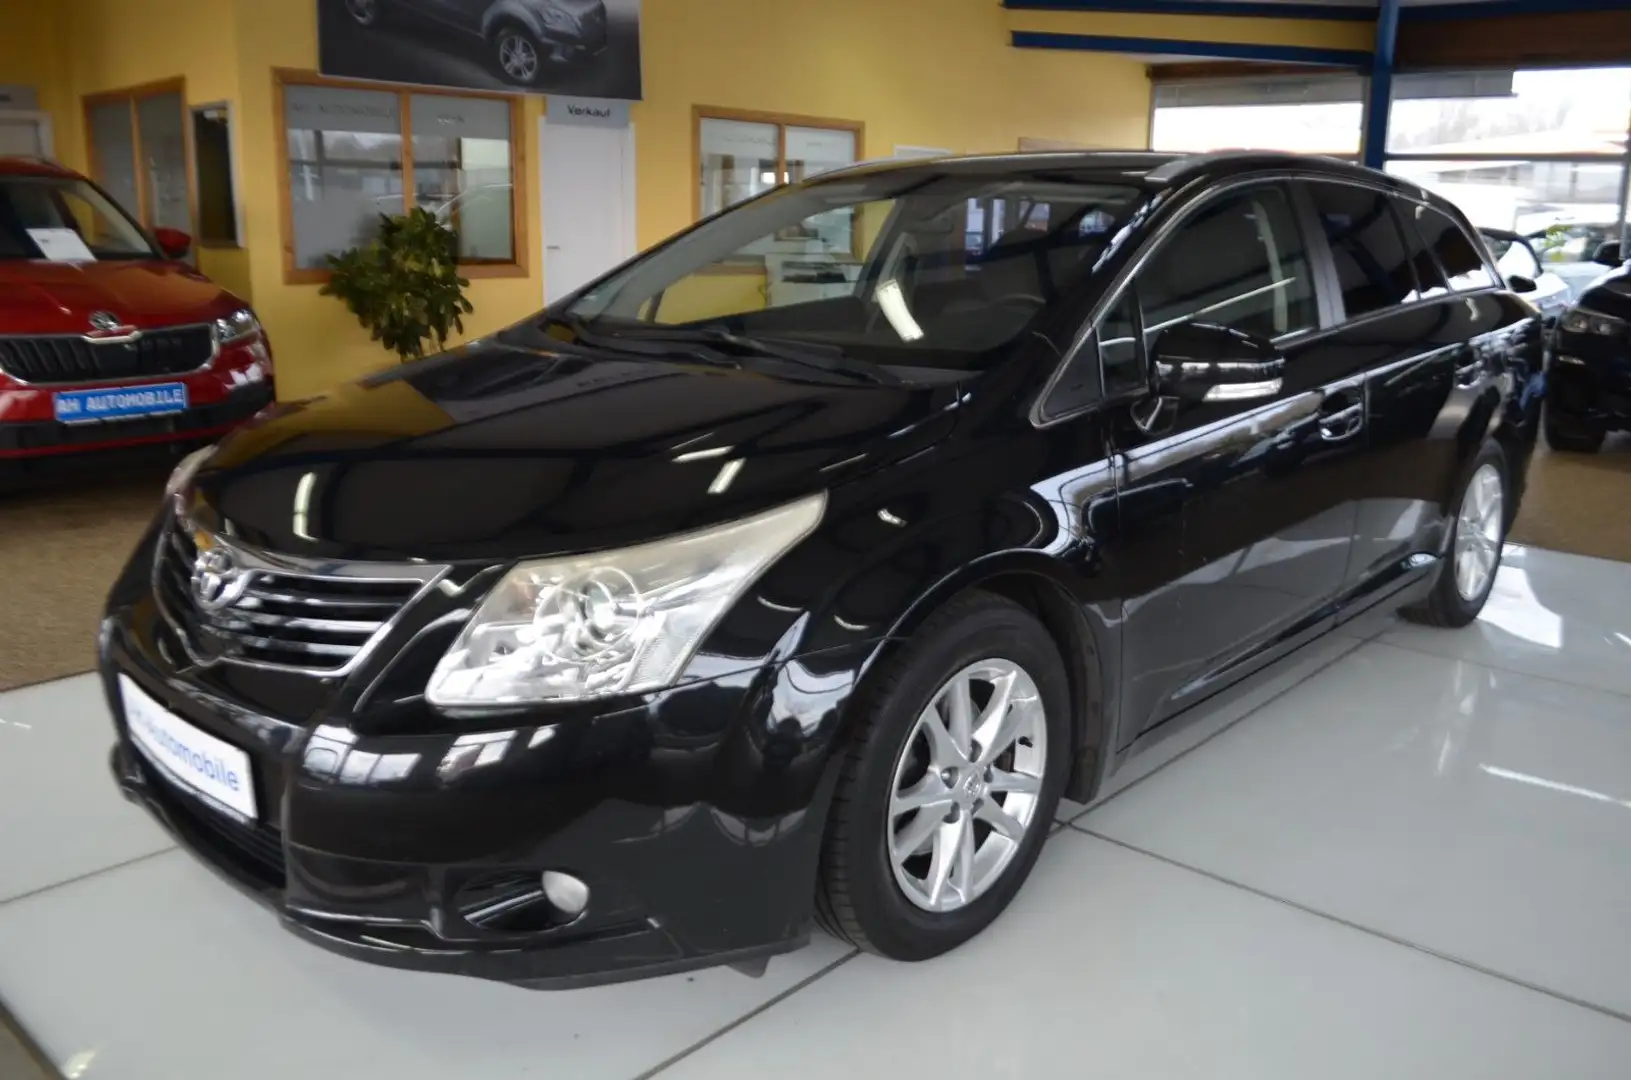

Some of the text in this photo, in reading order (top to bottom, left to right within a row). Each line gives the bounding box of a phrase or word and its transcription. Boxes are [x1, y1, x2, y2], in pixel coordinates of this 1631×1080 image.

[567, 104, 611, 118] Verkauf
[56, 388, 184, 413] AH AUTOMOBILE
